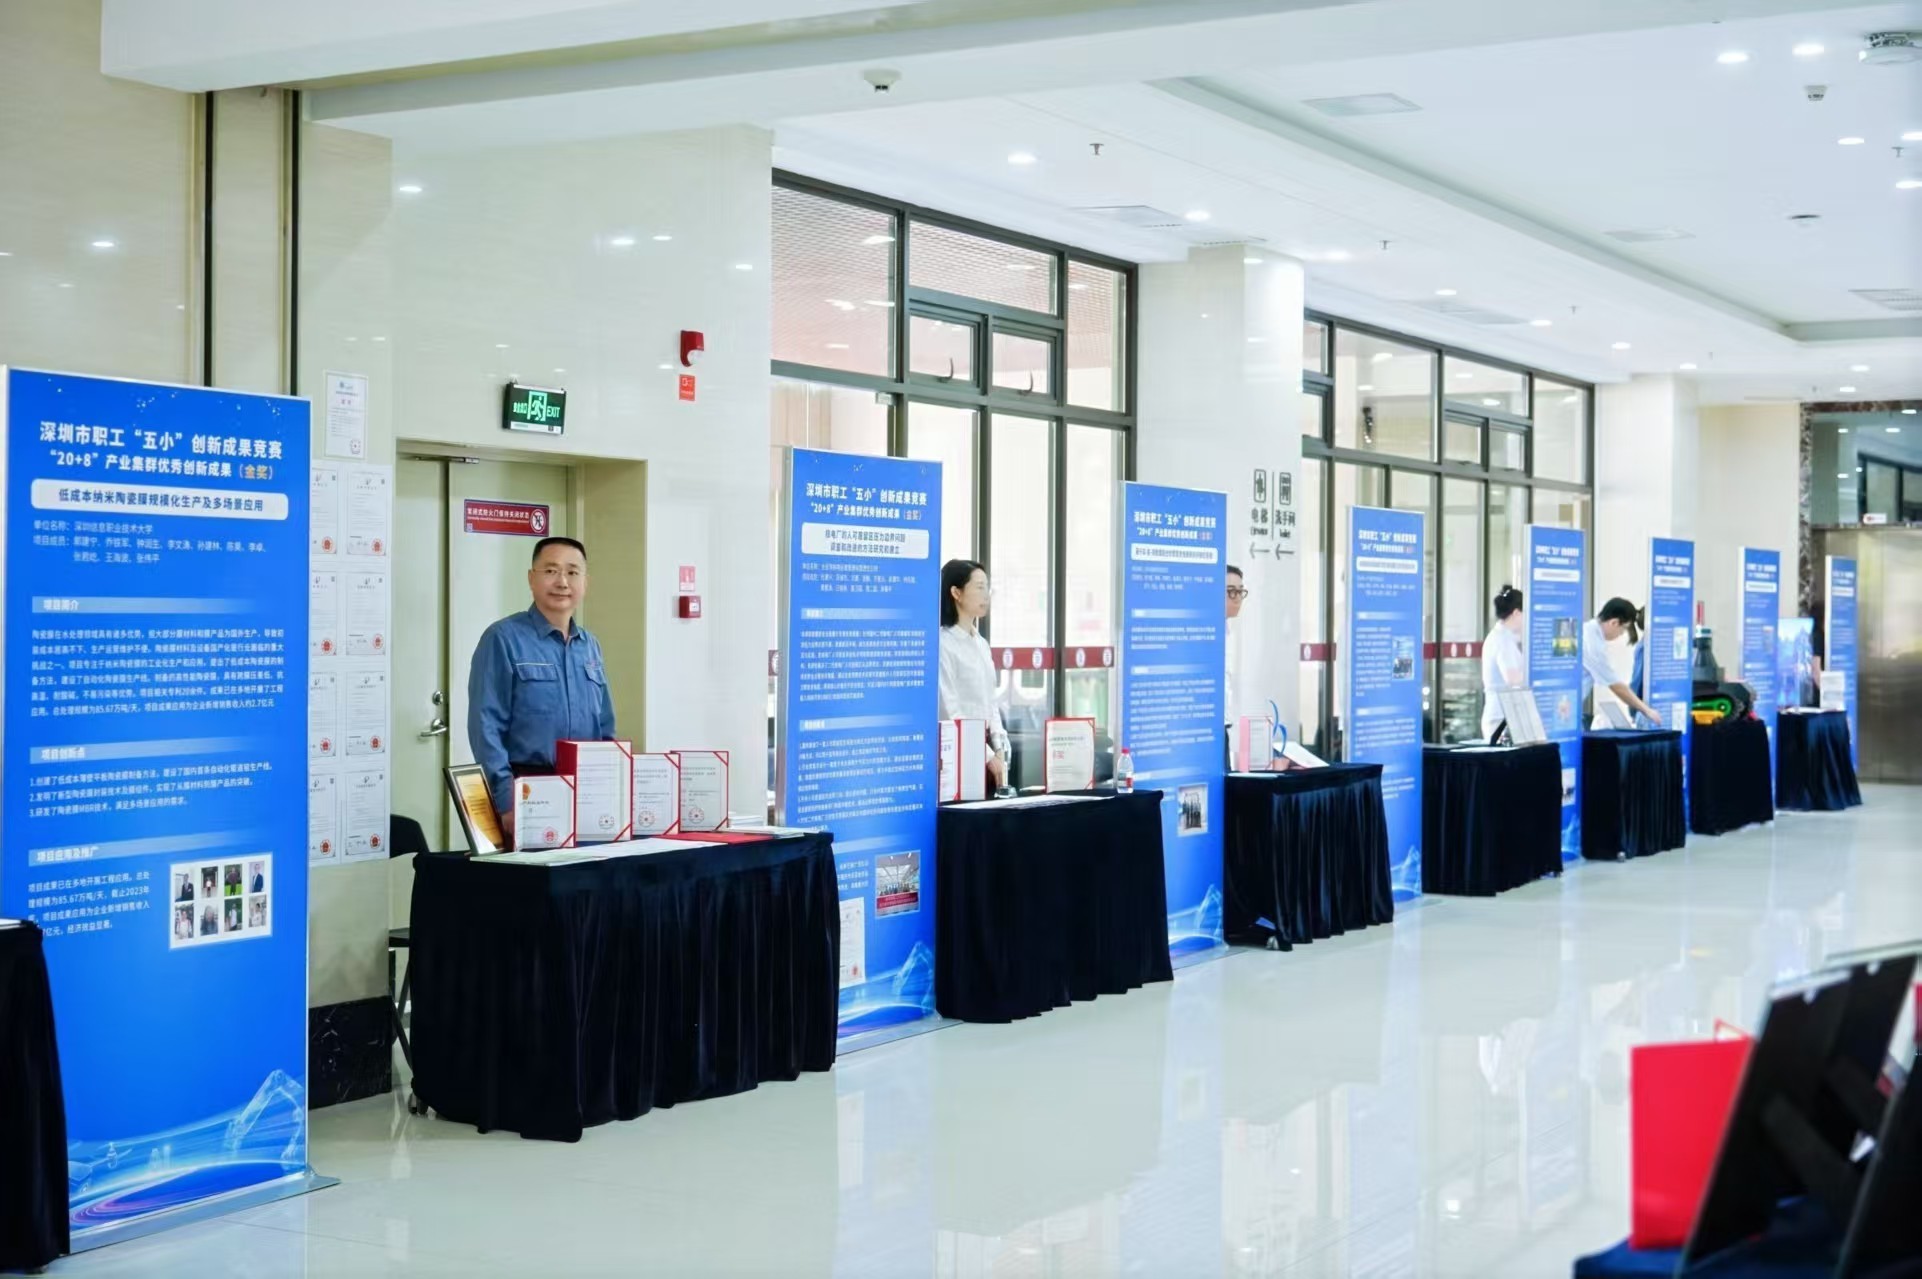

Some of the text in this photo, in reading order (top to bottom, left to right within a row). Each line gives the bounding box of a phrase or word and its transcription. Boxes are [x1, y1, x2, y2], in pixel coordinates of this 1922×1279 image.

[547, 406, 561, 418] EXIT
[39, 420, 283, 460] 深圳市职工“五小”创新成果竞赛
[58, 488, 264, 512] 低成本纳米陶瓷膜规模化生产及多场景应用
